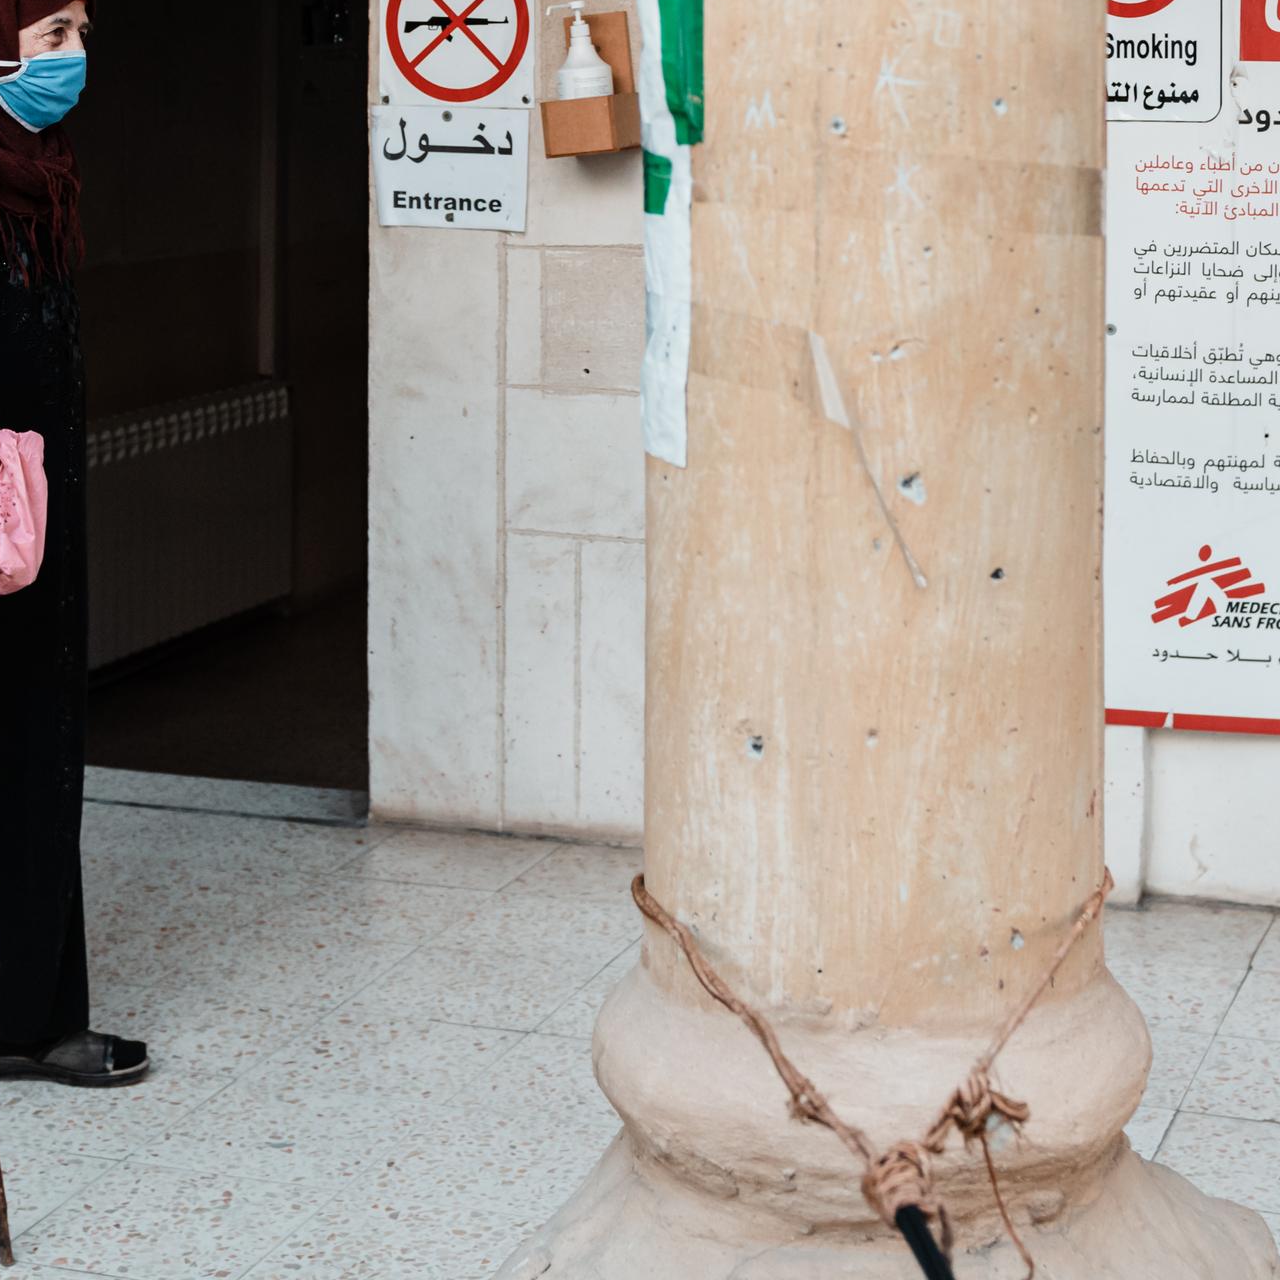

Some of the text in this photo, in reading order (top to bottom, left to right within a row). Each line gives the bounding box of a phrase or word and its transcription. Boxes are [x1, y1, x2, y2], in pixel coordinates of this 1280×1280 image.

[1105, 81, 1200, 111] ممنوع الت
[383, 117, 513, 163] دخول
[1239, 162, 1263, 176] من
[392, 190, 503, 214] Entrance
[1133, 239, 1157, 260] في
[1211, 615, 1253, 629] SANS
[1152, 648, 1219, 663] حدود
[1226, 648, 1272, 668] بلا
